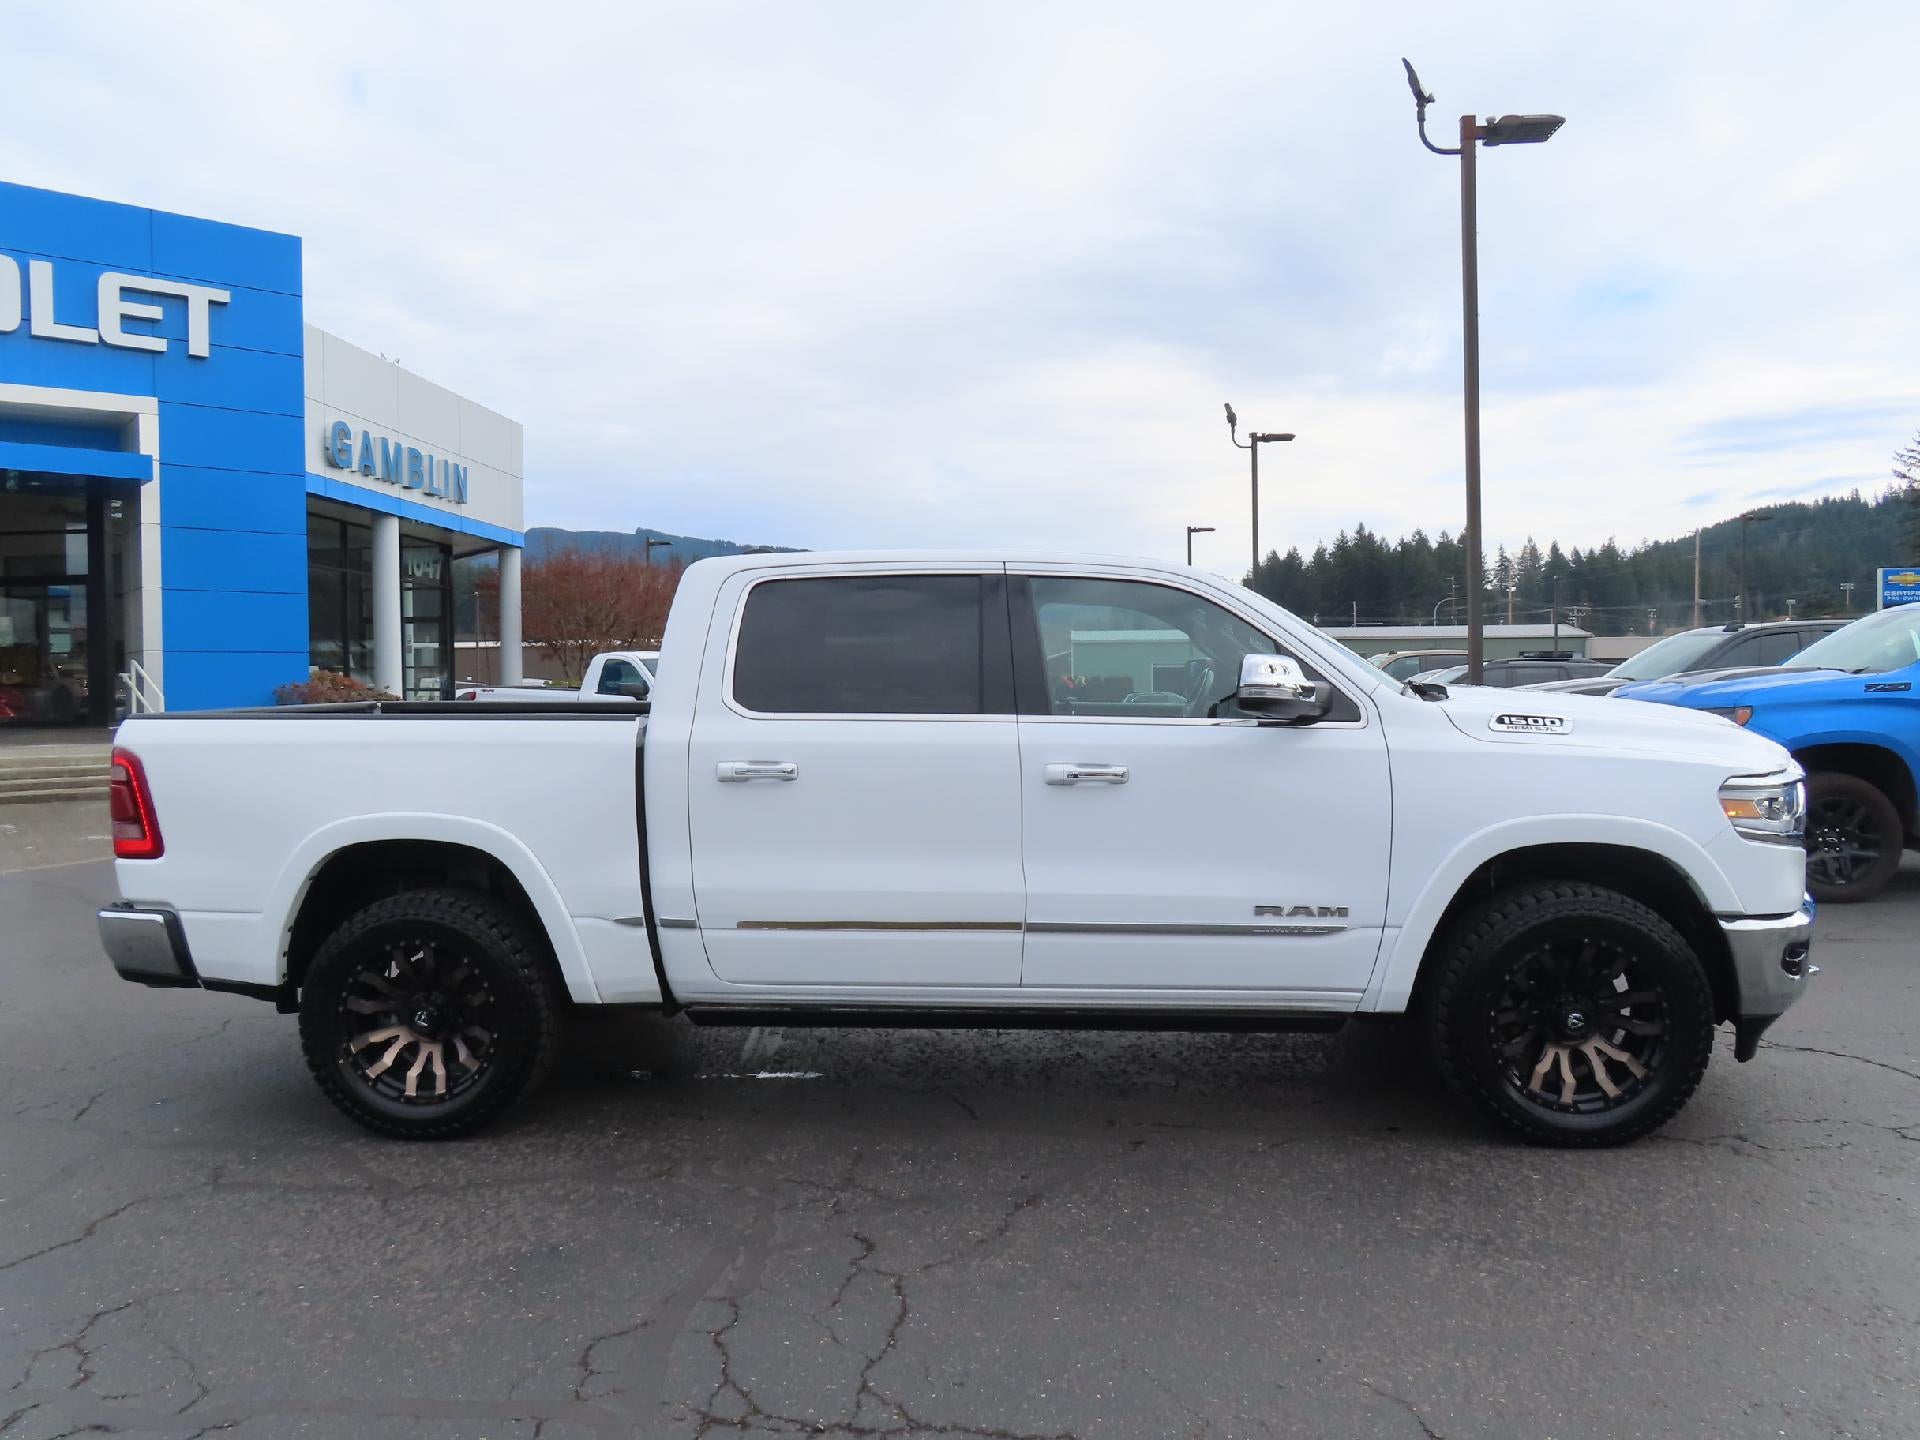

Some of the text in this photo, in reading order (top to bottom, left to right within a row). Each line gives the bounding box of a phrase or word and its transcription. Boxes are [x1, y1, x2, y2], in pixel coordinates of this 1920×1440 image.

[328, 420, 468, 504] GAMBLIN
[1502, 716, 1561, 727] 1500
[1254, 905, 1349, 918] RAM
